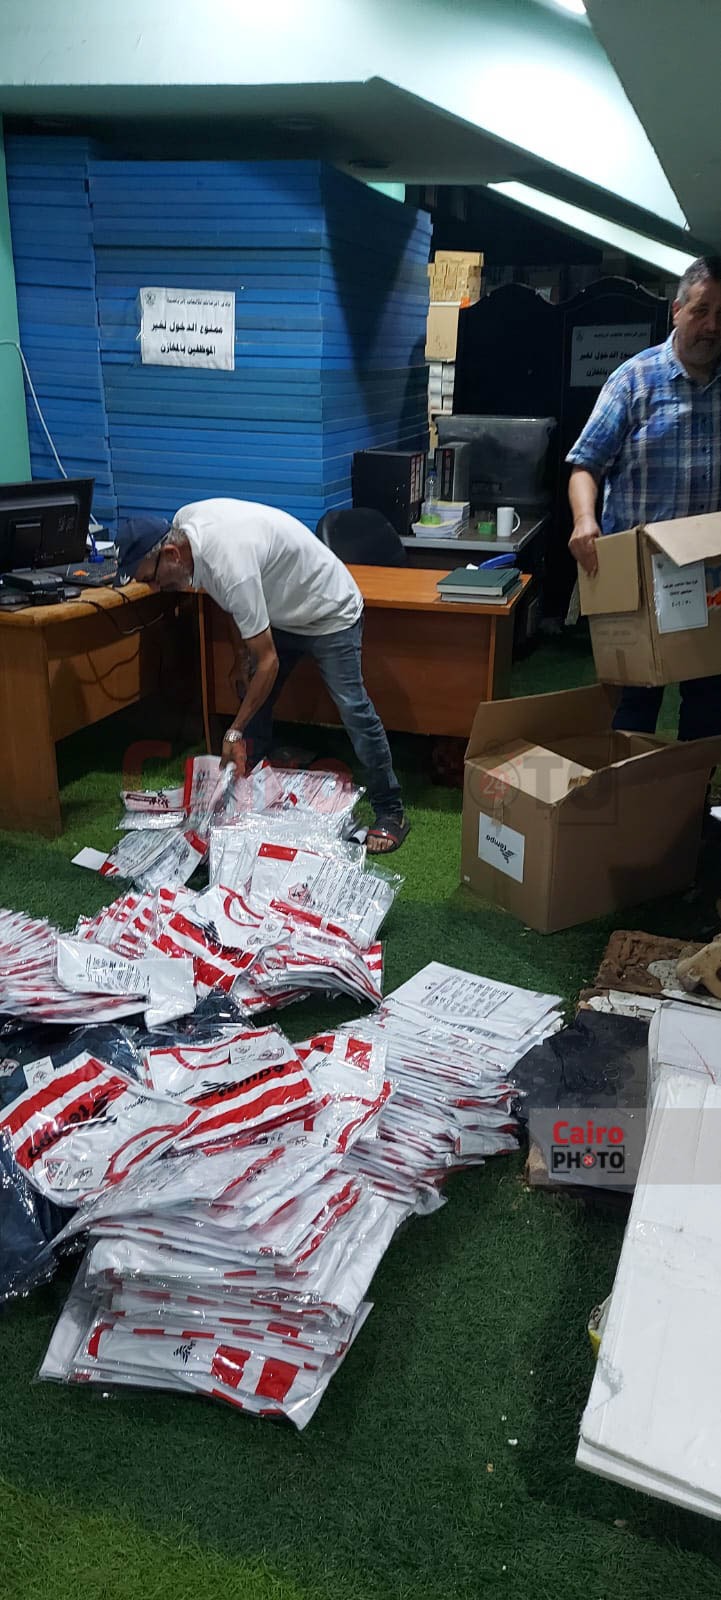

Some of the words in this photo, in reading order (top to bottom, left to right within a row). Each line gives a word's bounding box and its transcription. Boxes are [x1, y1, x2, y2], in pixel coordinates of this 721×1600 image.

[151, 320, 167, 331] لغير
[169, 321, 197, 333] الدخول
[199, 323, 223, 335] ممنوع
[160, 342, 186, 354] بالمخازن
[187, 344, 216, 357] الموظفين
[485, 833, 508, 852] tempo
